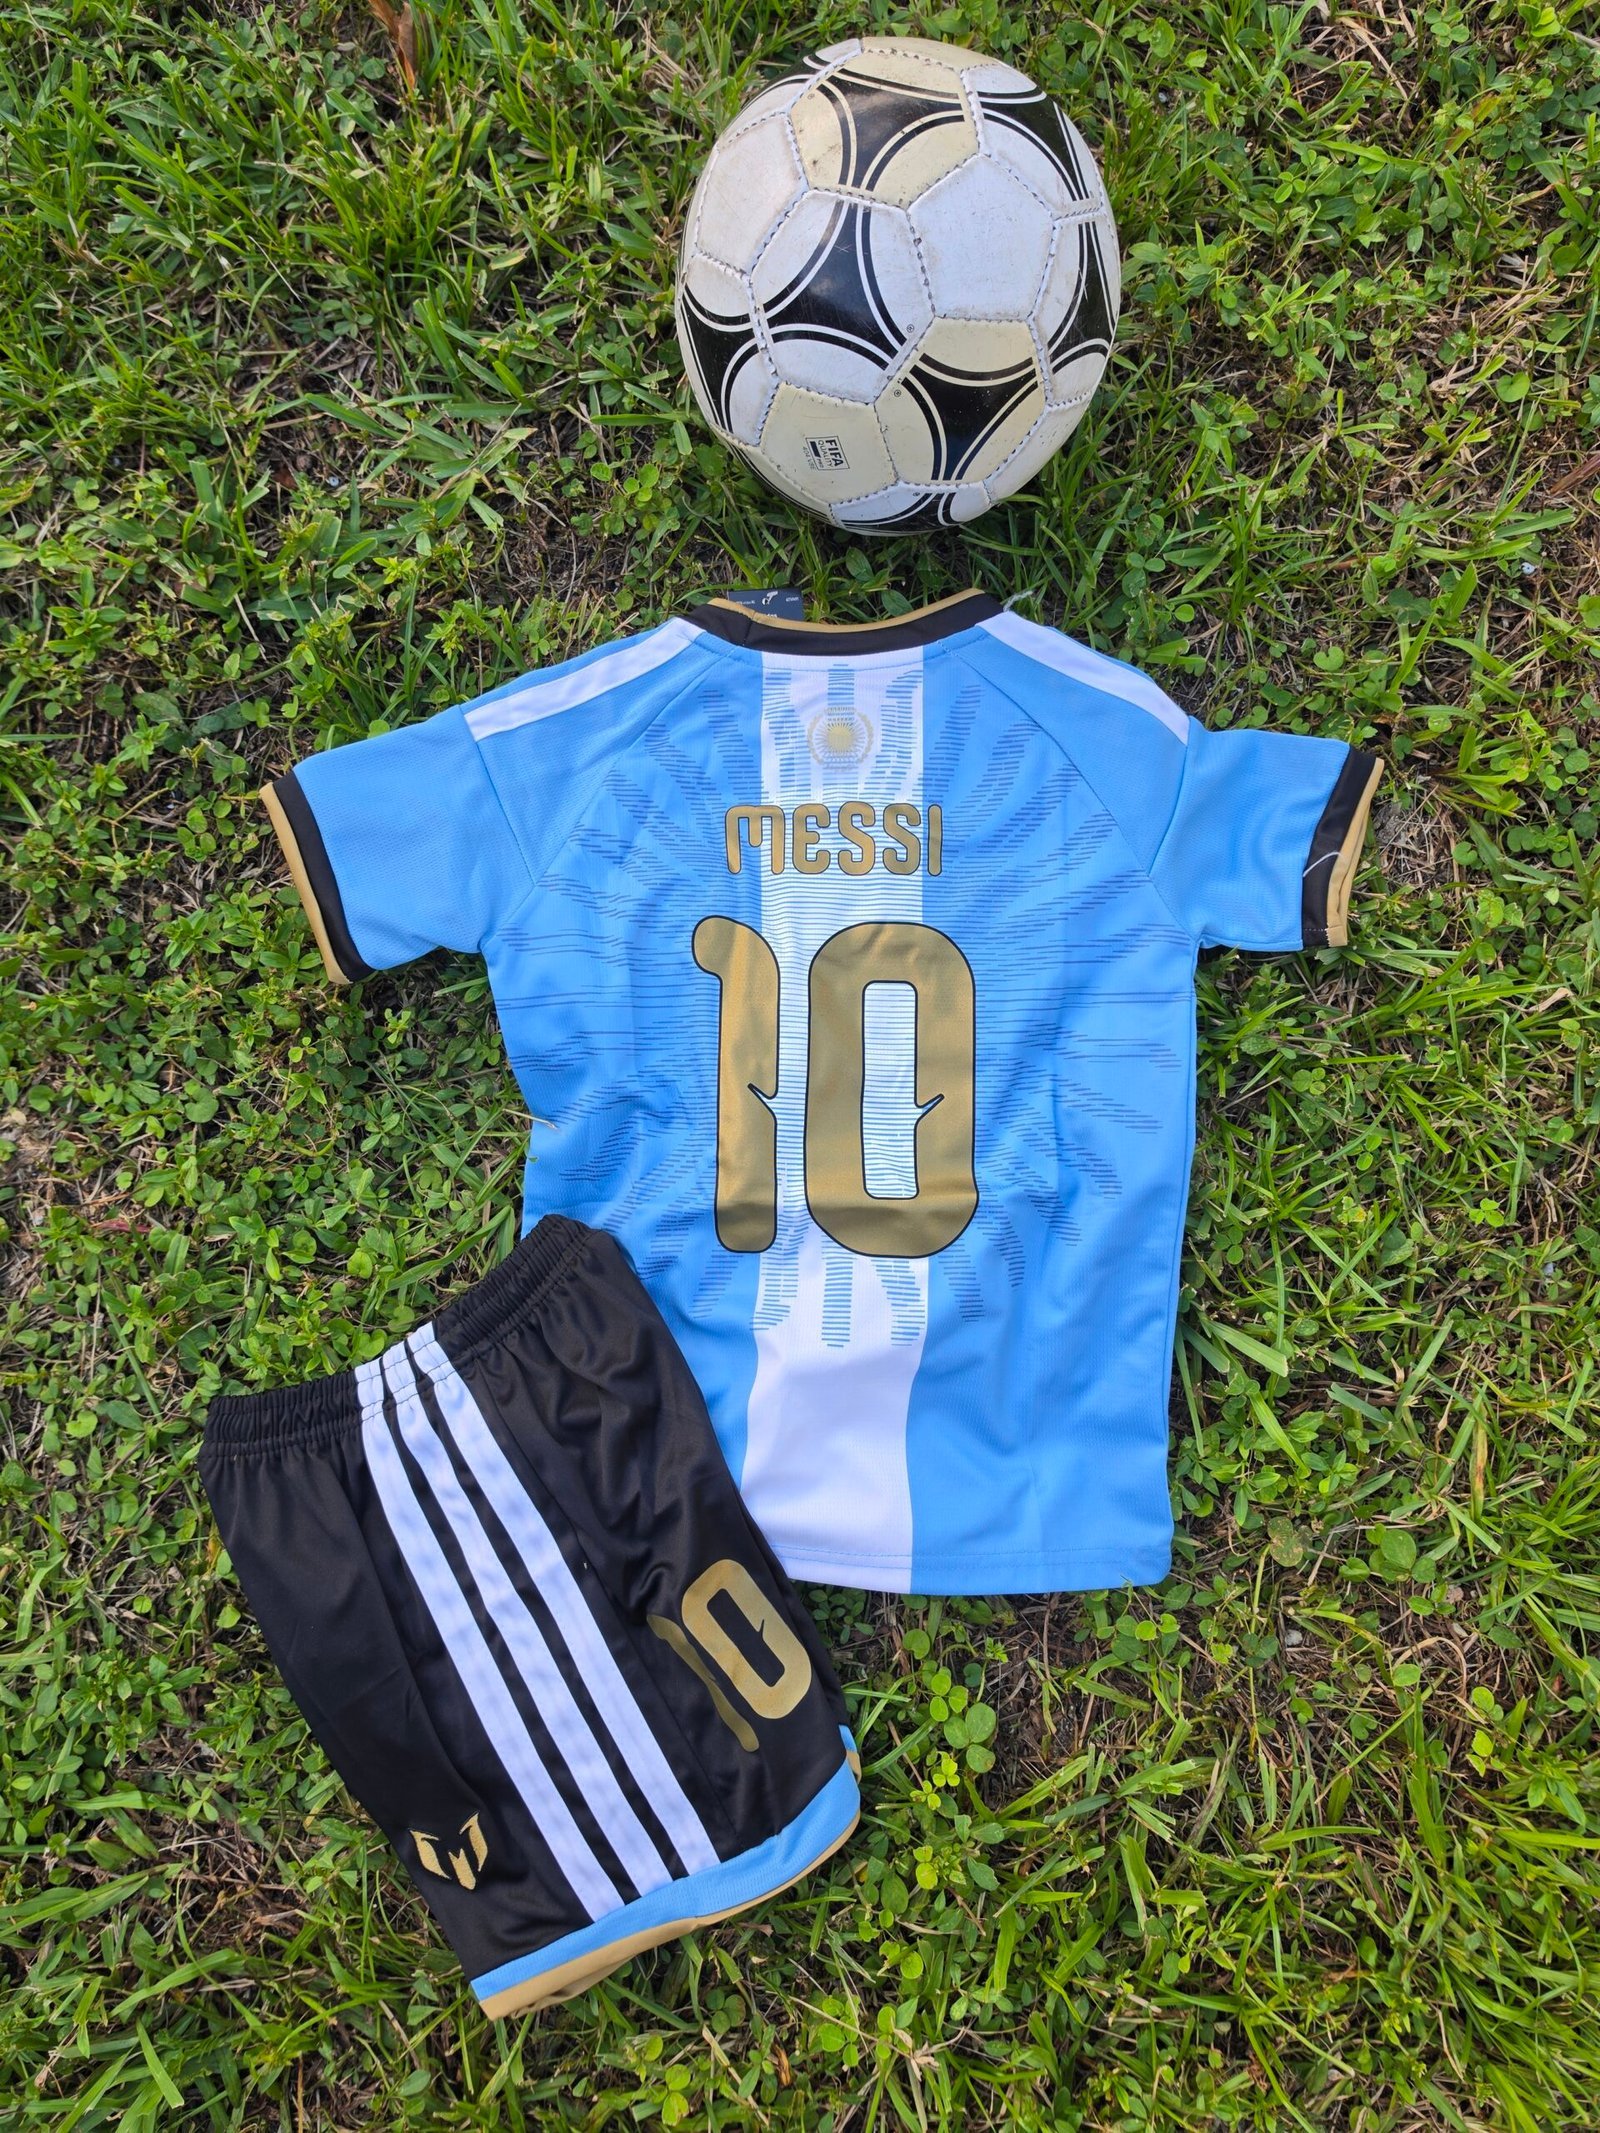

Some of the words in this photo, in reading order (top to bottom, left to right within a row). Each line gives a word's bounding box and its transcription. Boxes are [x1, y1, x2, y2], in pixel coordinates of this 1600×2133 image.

[818, 439, 834, 468] QUALITY
[825, 439, 844, 467] FIFA
[724, 801, 943, 877] MESSI
[691, 914, 980, 1259] 10
[646, 1558, 812, 1753] 10
